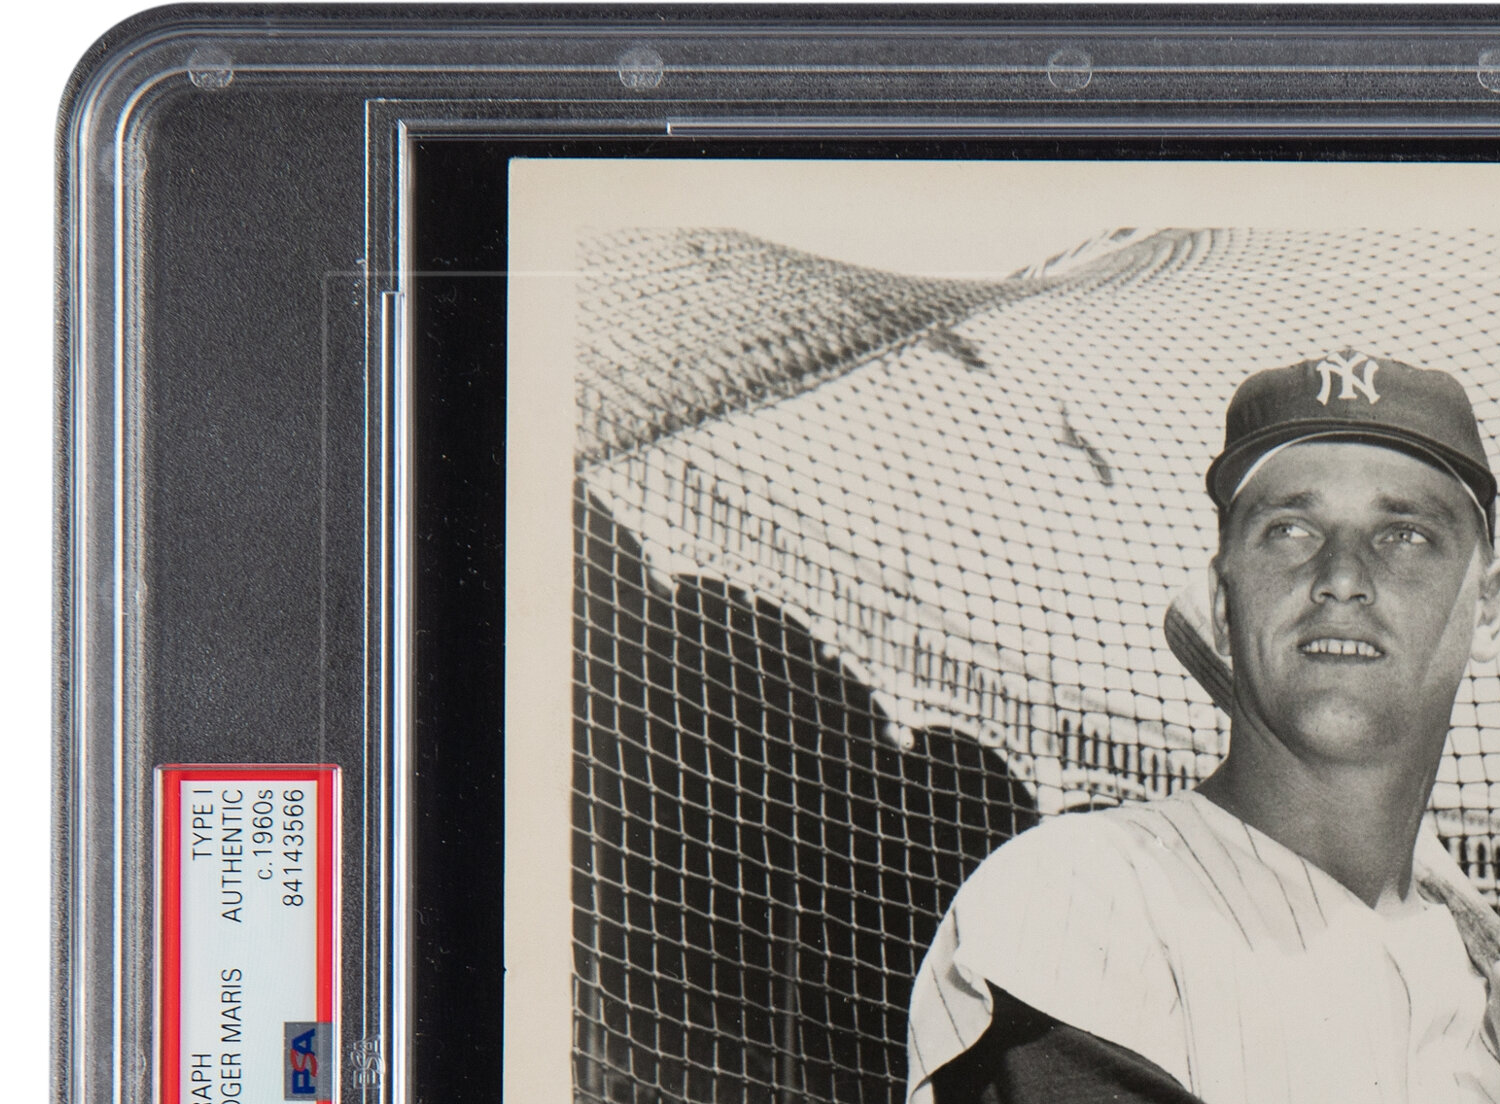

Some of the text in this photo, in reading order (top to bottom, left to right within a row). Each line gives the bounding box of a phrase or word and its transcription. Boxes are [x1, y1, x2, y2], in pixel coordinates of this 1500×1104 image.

[191, 803, 213, 861] TYPE
[220, 788, 244, 923] AUTHENTIC
[281, 788, 305, 907] 84143566
[219, 967, 243, 1043] MARIS
[290, 1028, 318, 1094] PSA
